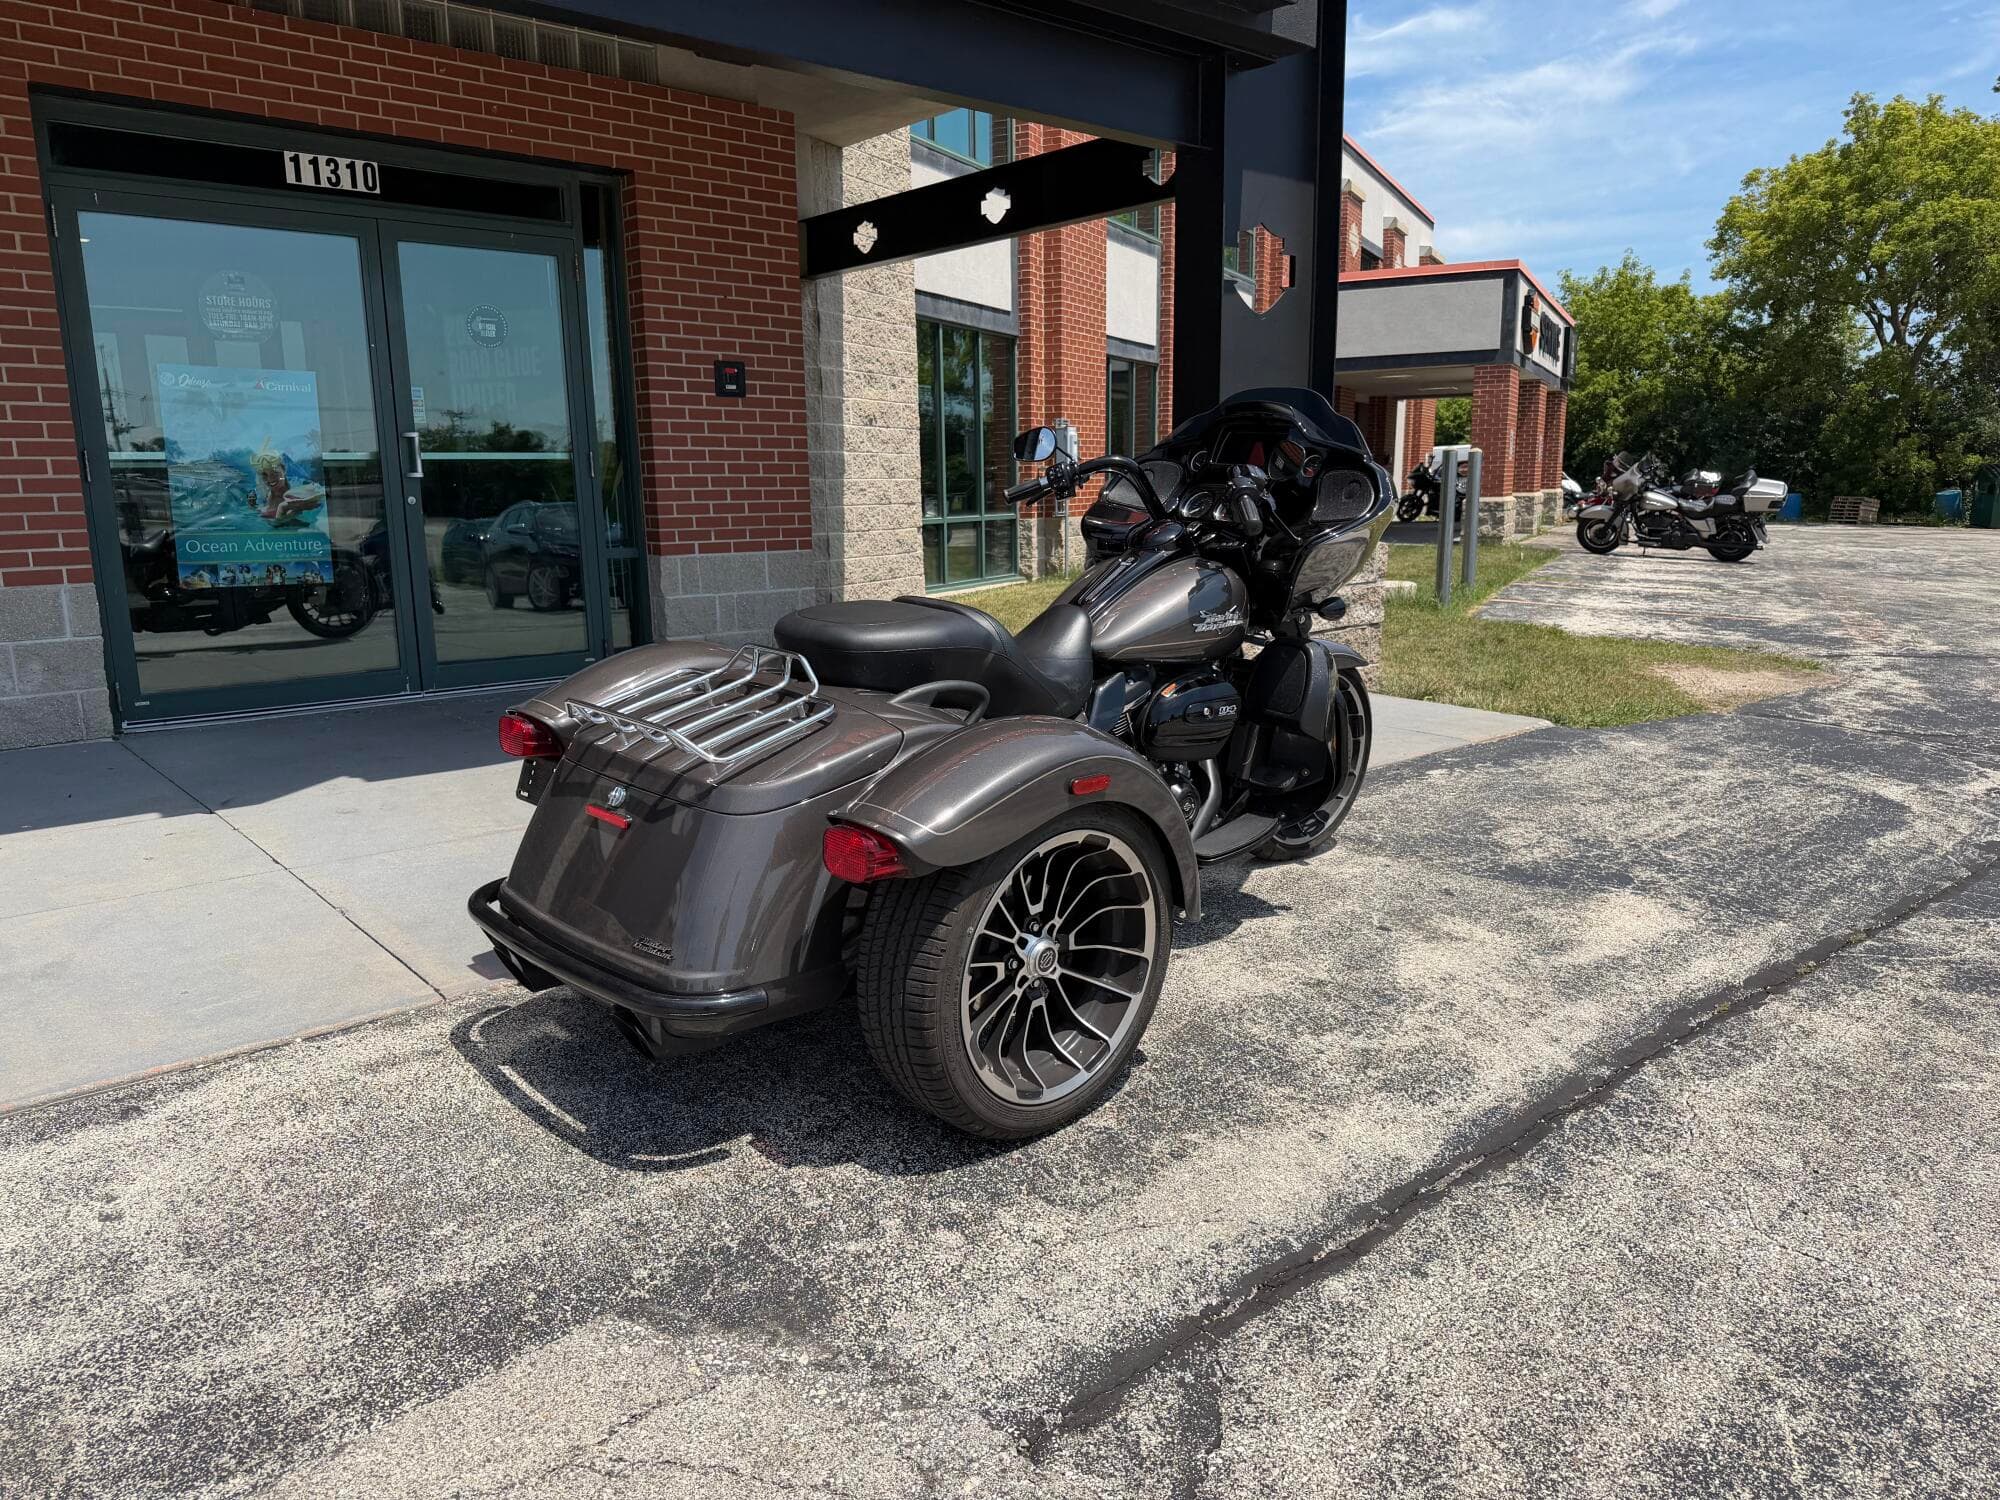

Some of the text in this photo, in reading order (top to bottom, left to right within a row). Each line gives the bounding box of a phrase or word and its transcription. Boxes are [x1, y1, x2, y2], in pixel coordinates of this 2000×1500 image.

[289, 153, 377, 191] 11310
[206, 296, 272, 309] STORE HOURS
[266, 381, 311, 393] Carnival
[185, 538, 322, 553] Ocean Adventure
